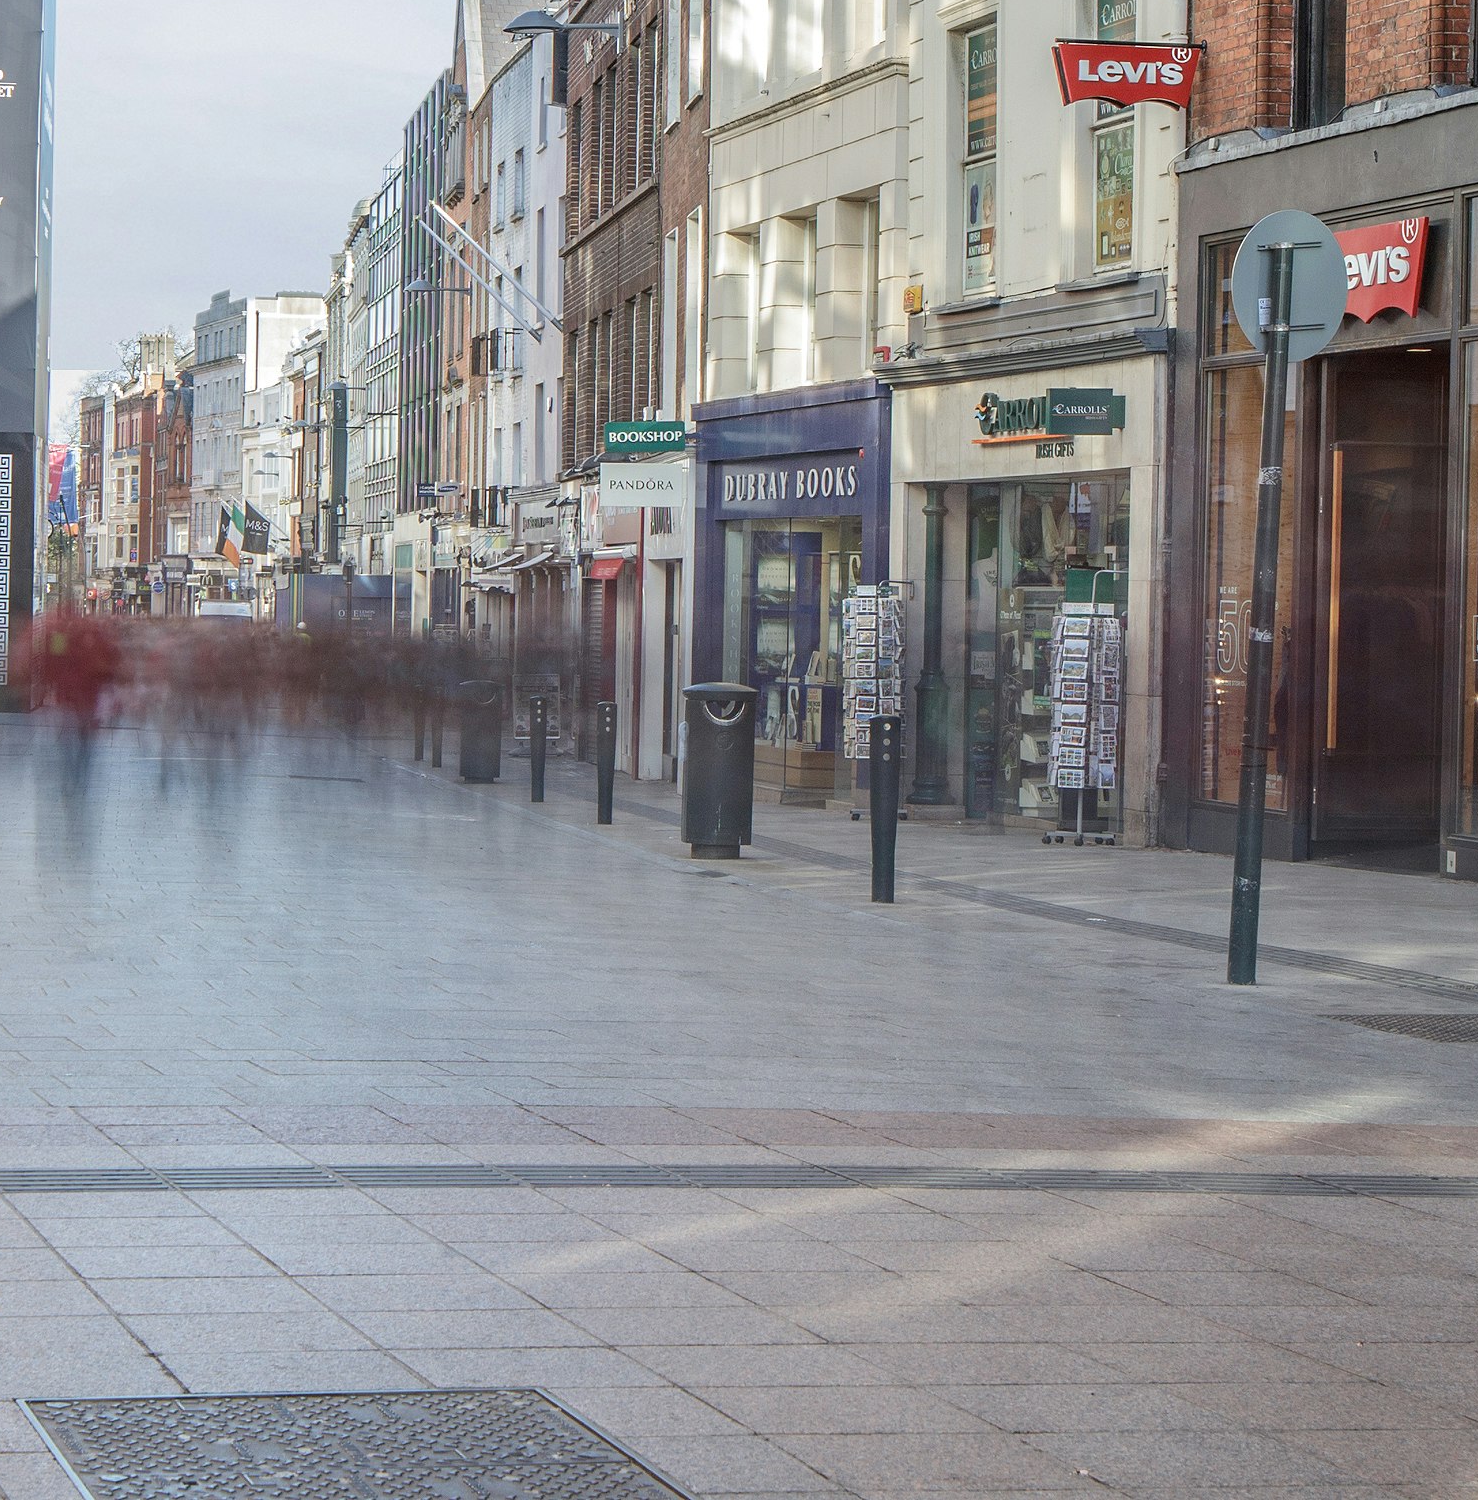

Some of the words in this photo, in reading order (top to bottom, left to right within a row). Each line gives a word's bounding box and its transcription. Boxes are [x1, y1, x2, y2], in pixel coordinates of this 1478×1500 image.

[1056, 403, 1108, 414] CARROLLS
[609, 431, 683, 443] BOOKSHOP
[1036, 443, 1054, 460] IRISH
[1055, 441, 1075, 458] GIFTS
[724, 471, 789, 502] DUBRAY
[796, 465, 857, 499] BOOKS
[245, 518, 269, 532] M&S
[1228, 586, 1238, 594] ARE
[1217, 599, 1252, 675] 50
